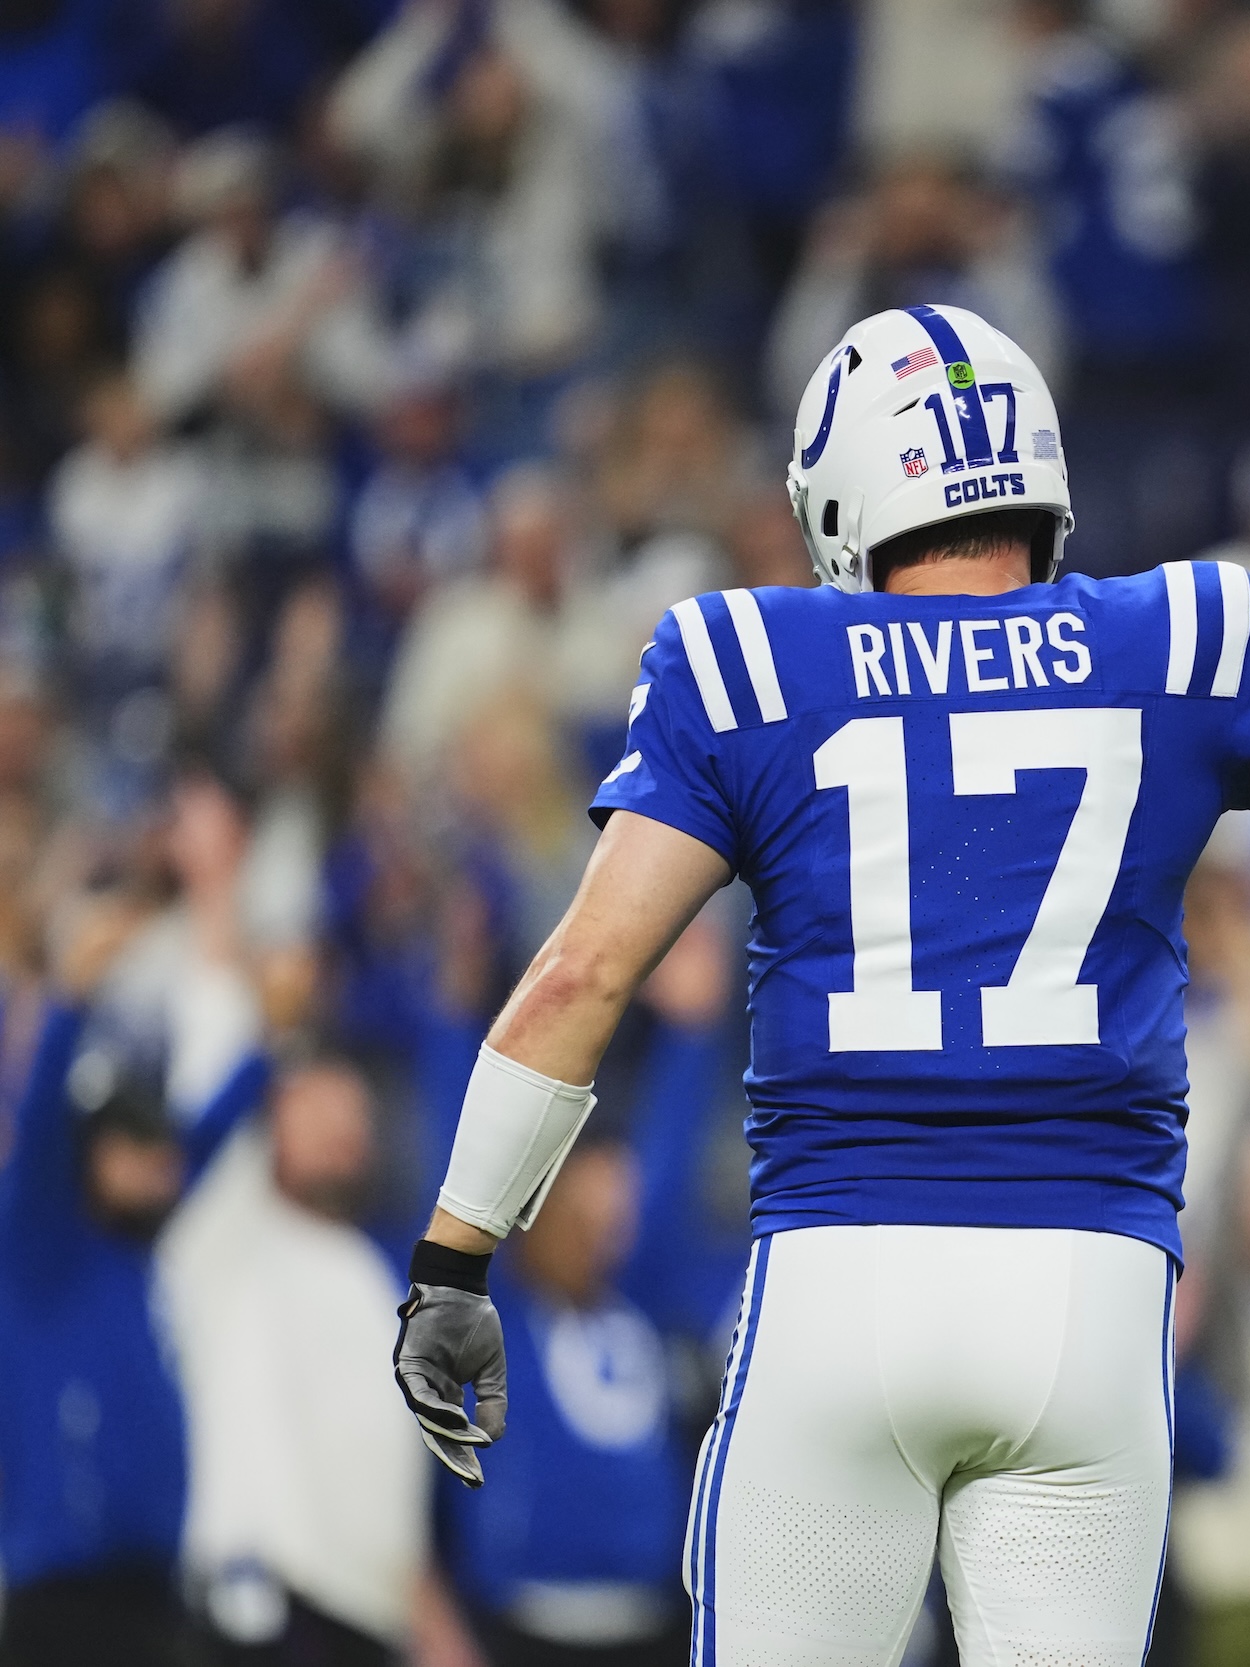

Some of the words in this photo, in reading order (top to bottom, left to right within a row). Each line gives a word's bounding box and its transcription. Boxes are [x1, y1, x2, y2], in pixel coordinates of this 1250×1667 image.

[905, 459, 927, 475] NFL
[924, 383, 1019, 474] 17
[944, 473, 1025, 508] COLTS
[846, 612, 1093, 698] RIVERS
[813, 708, 1143, 1052] 17
